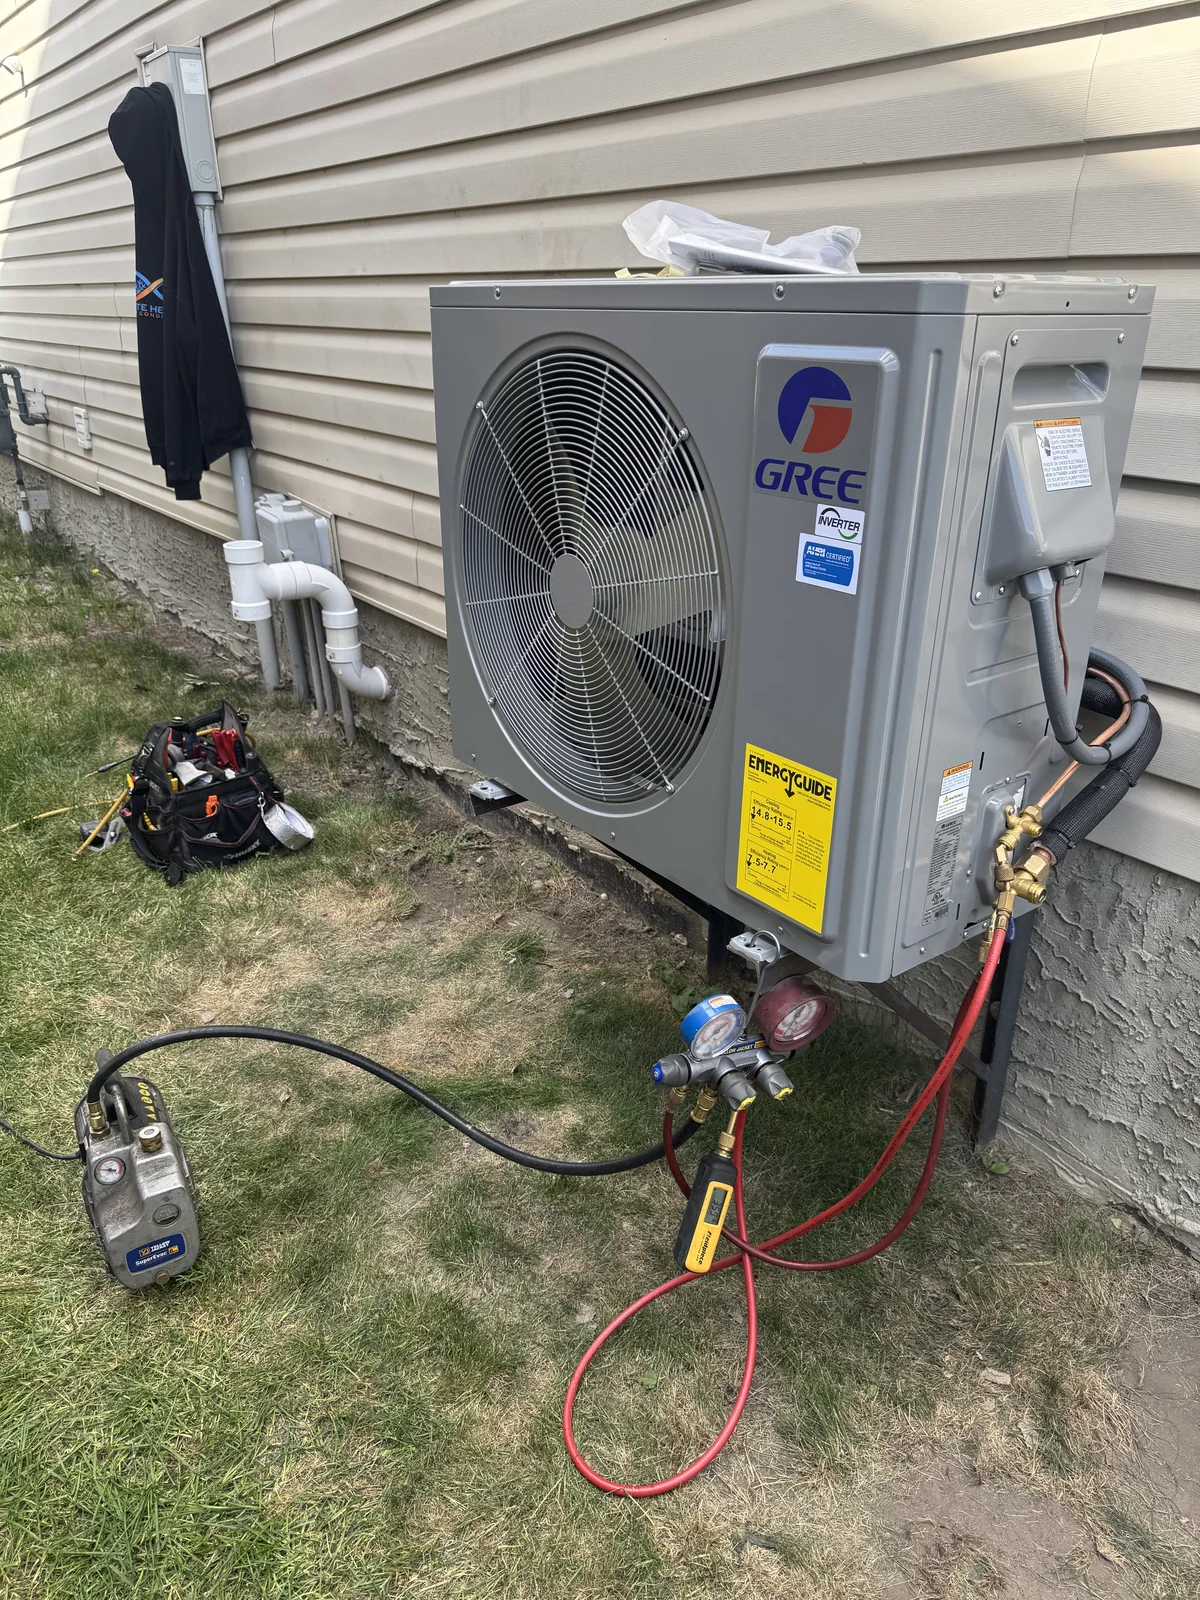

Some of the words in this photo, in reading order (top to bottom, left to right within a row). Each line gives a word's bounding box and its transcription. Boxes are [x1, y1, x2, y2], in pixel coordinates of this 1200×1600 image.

[150, 305, 163, 314] HE
[755, 458, 866, 504] GREE
[818, 515, 860, 532] INVERTER
[806, 545, 826, 557] AHRI
[749, 754, 832, 801] ENERGYGUIDE
[765, 798, 779, 809] Cooling
[752, 806, 791, 830] 14.8-15.5
[748, 853, 776, 874] 7.5-7.7
[698, 1230, 713, 1265] Fieldpiece
[135, 1251, 168, 1266] SuperEvac
